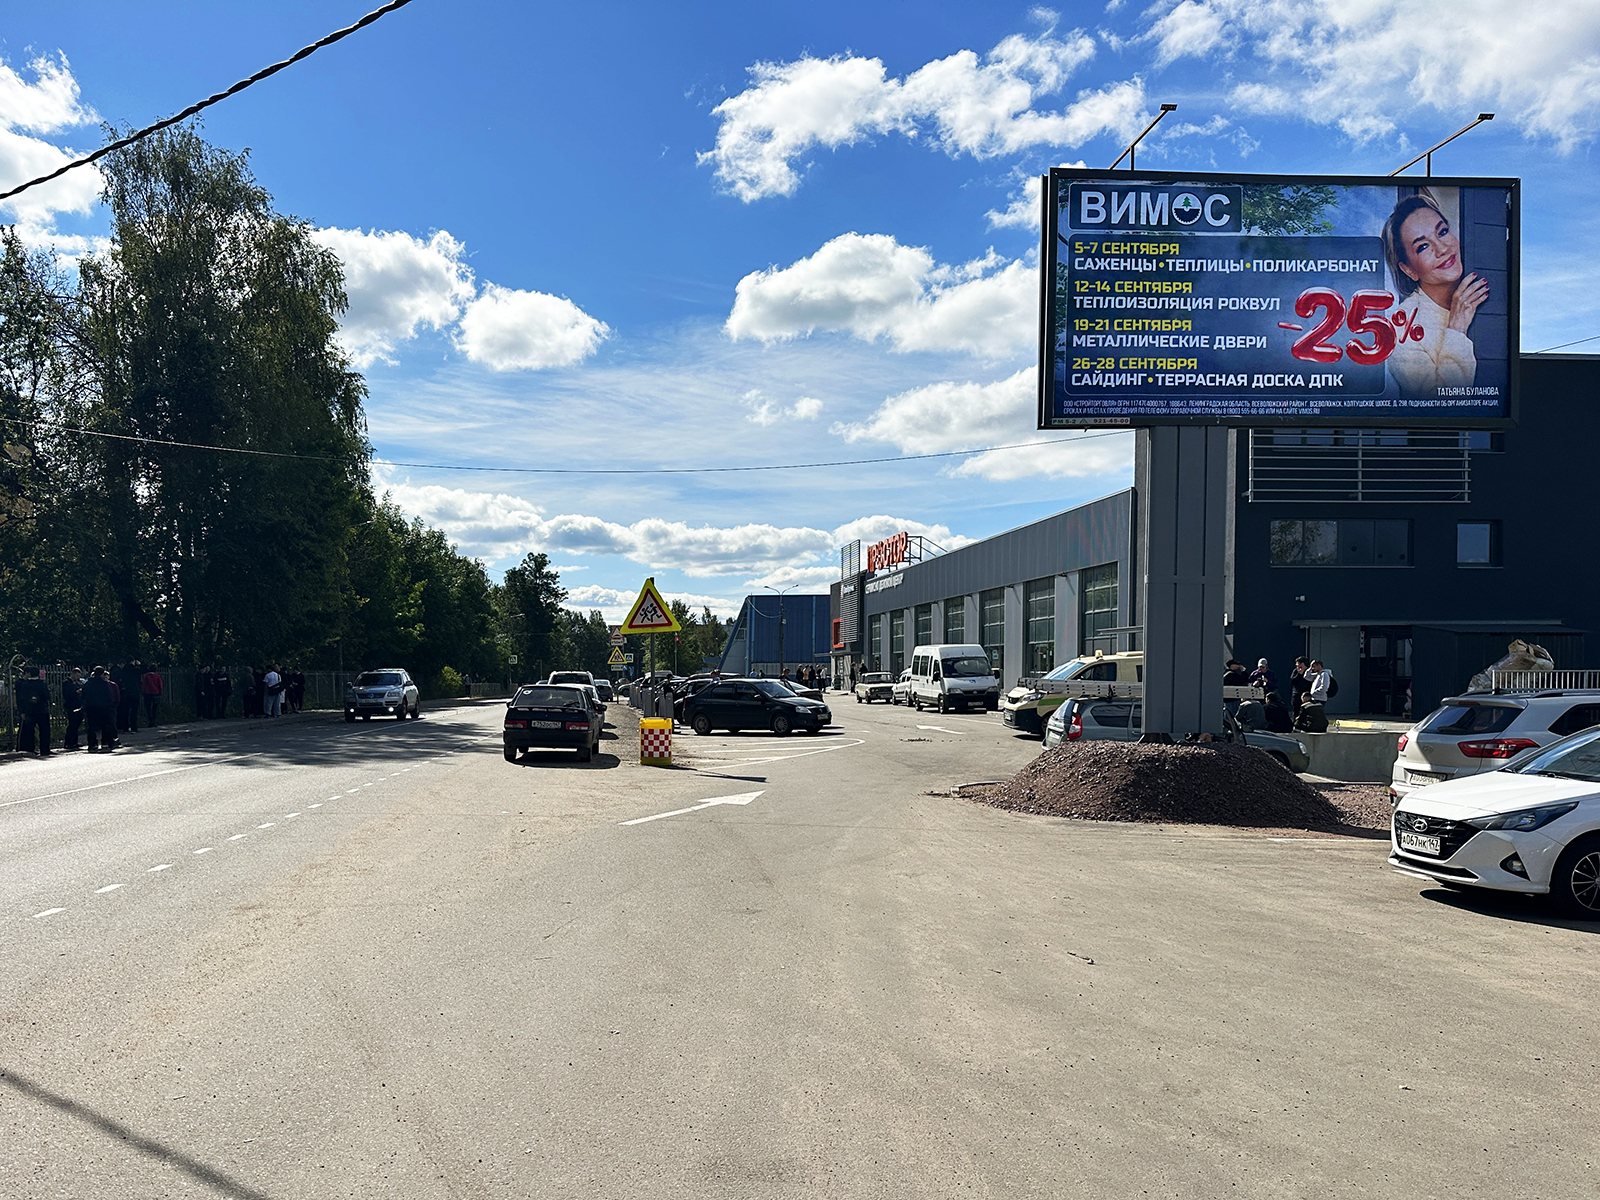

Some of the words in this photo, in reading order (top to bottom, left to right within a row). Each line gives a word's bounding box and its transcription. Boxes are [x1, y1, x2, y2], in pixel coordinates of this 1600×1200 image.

[1080, 191, 1231, 227] ВИМОС
[1074, 242, 1098, 254] 5-7
[1102, 242, 1180, 255] СЕНТЯБРЯ
[1074, 258, 1157, 273] САЖЕНЦЫ
[1165, 259, 1244, 274] ТЕПЛИЦЫ
[1252, 259, 1379, 273] ПОЛИКАРБОНАТ
[1074, 281, 1111, 293] 12-14
[1114, 281, 1193, 294] СЕНТЯБРЯ
[1073, 296, 1213, 311] ТЕПЛОИЗОЛЯЦИЯ
[1218, 298, 1281, 311] РОКВУЛ
[1073, 319, 1110, 331] 19-21
[1113, 319, 1192, 332] СЕНТЯБРЯ
[1072, 335, 1210, 349] МЕТАЛЛИЧЕСКИЕ
[1213, 336, 1267, 350] ДВЕРИ
[1072, 358, 1115, 370] 26-28
[1119, 358, 1198, 370] СЕНТЯБРЯ
[1071, 371, 1148, 388] САЙДИНГ
[1155, 373, 1247, 387] ТЕРРАСНАЯ
[1251, 374, 1305, 389] ДОСКА
[1308, 374, 1344, 389] ДПК
[1437, 387, 1465, 396] ТАТЬЯНА
[1466, 387, 1499, 396] БУЛАНОВА
